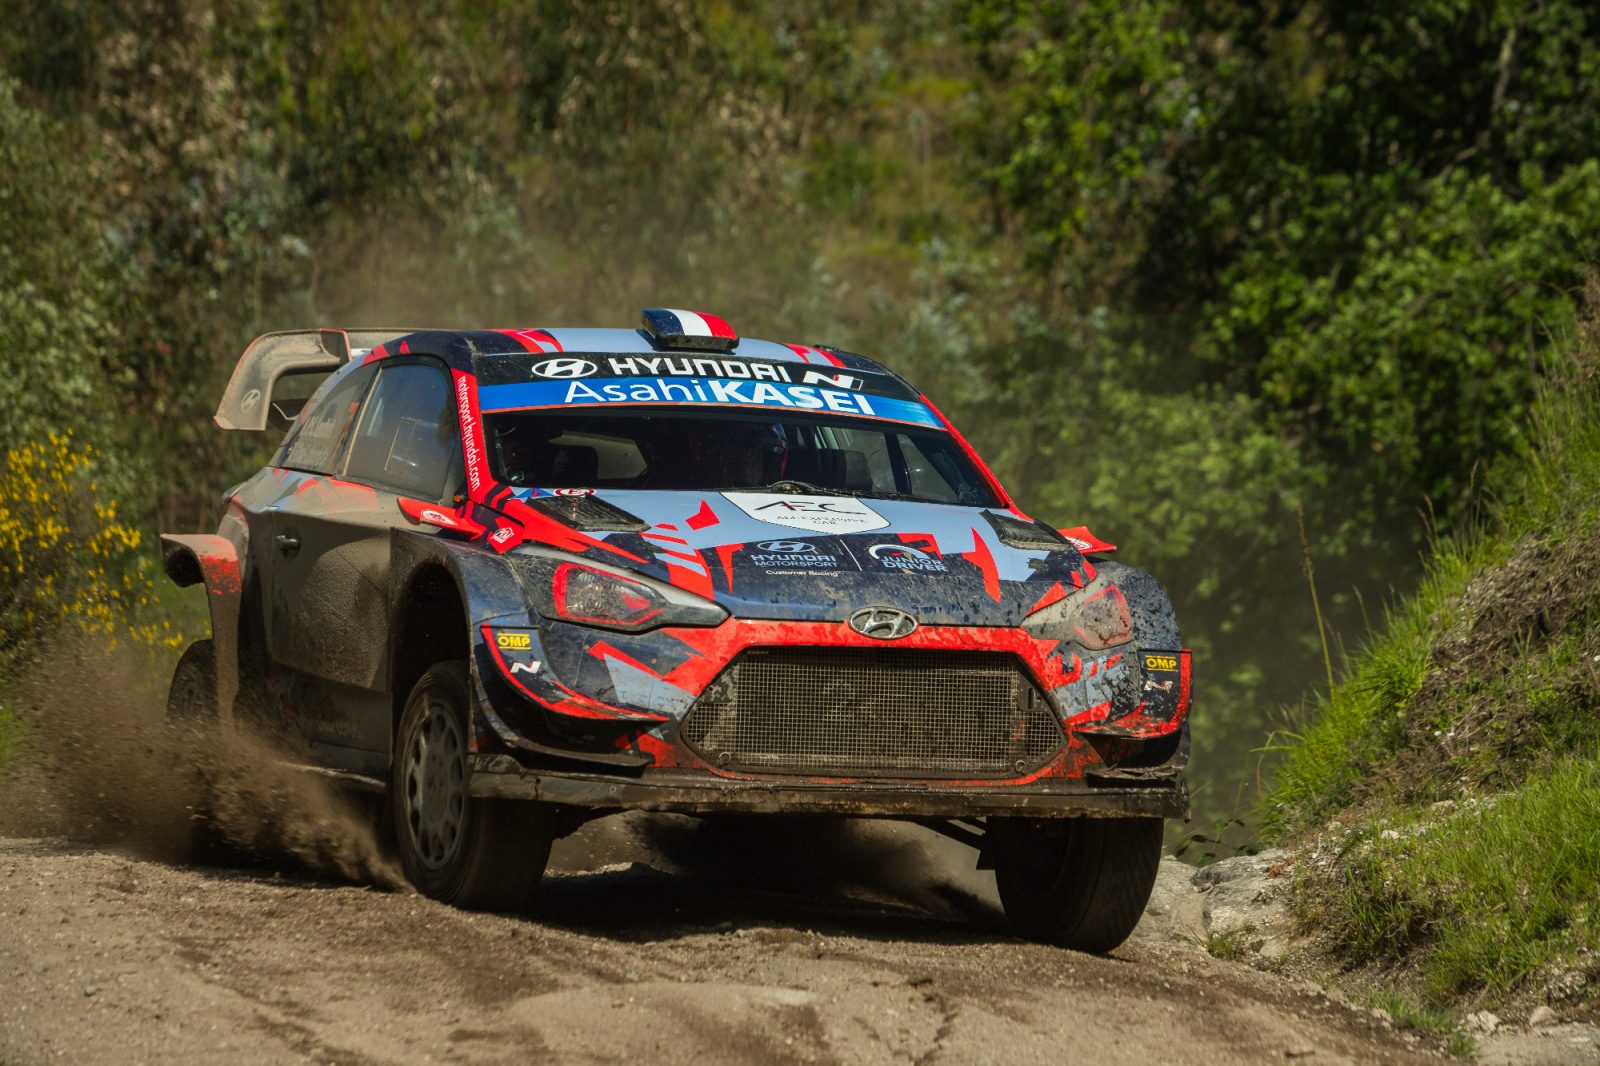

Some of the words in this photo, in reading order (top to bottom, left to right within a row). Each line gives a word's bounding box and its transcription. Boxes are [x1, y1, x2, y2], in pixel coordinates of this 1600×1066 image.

[608, 357, 792, 383] HYUNDAI
[564, 378, 876, 416] AsahiKASEI
[457, 375, 481, 492] motorsport.hyundai.com
[750, 554, 837, 562] HYUNDAI
[755, 560, 838, 568] MOTORSPORT
[881, 556, 944, 565] JUNIOR
[881, 561, 950, 573] DRIVER
[497, 635, 531, 648] OMP
[1146, 657, 1178, 669] OMP
